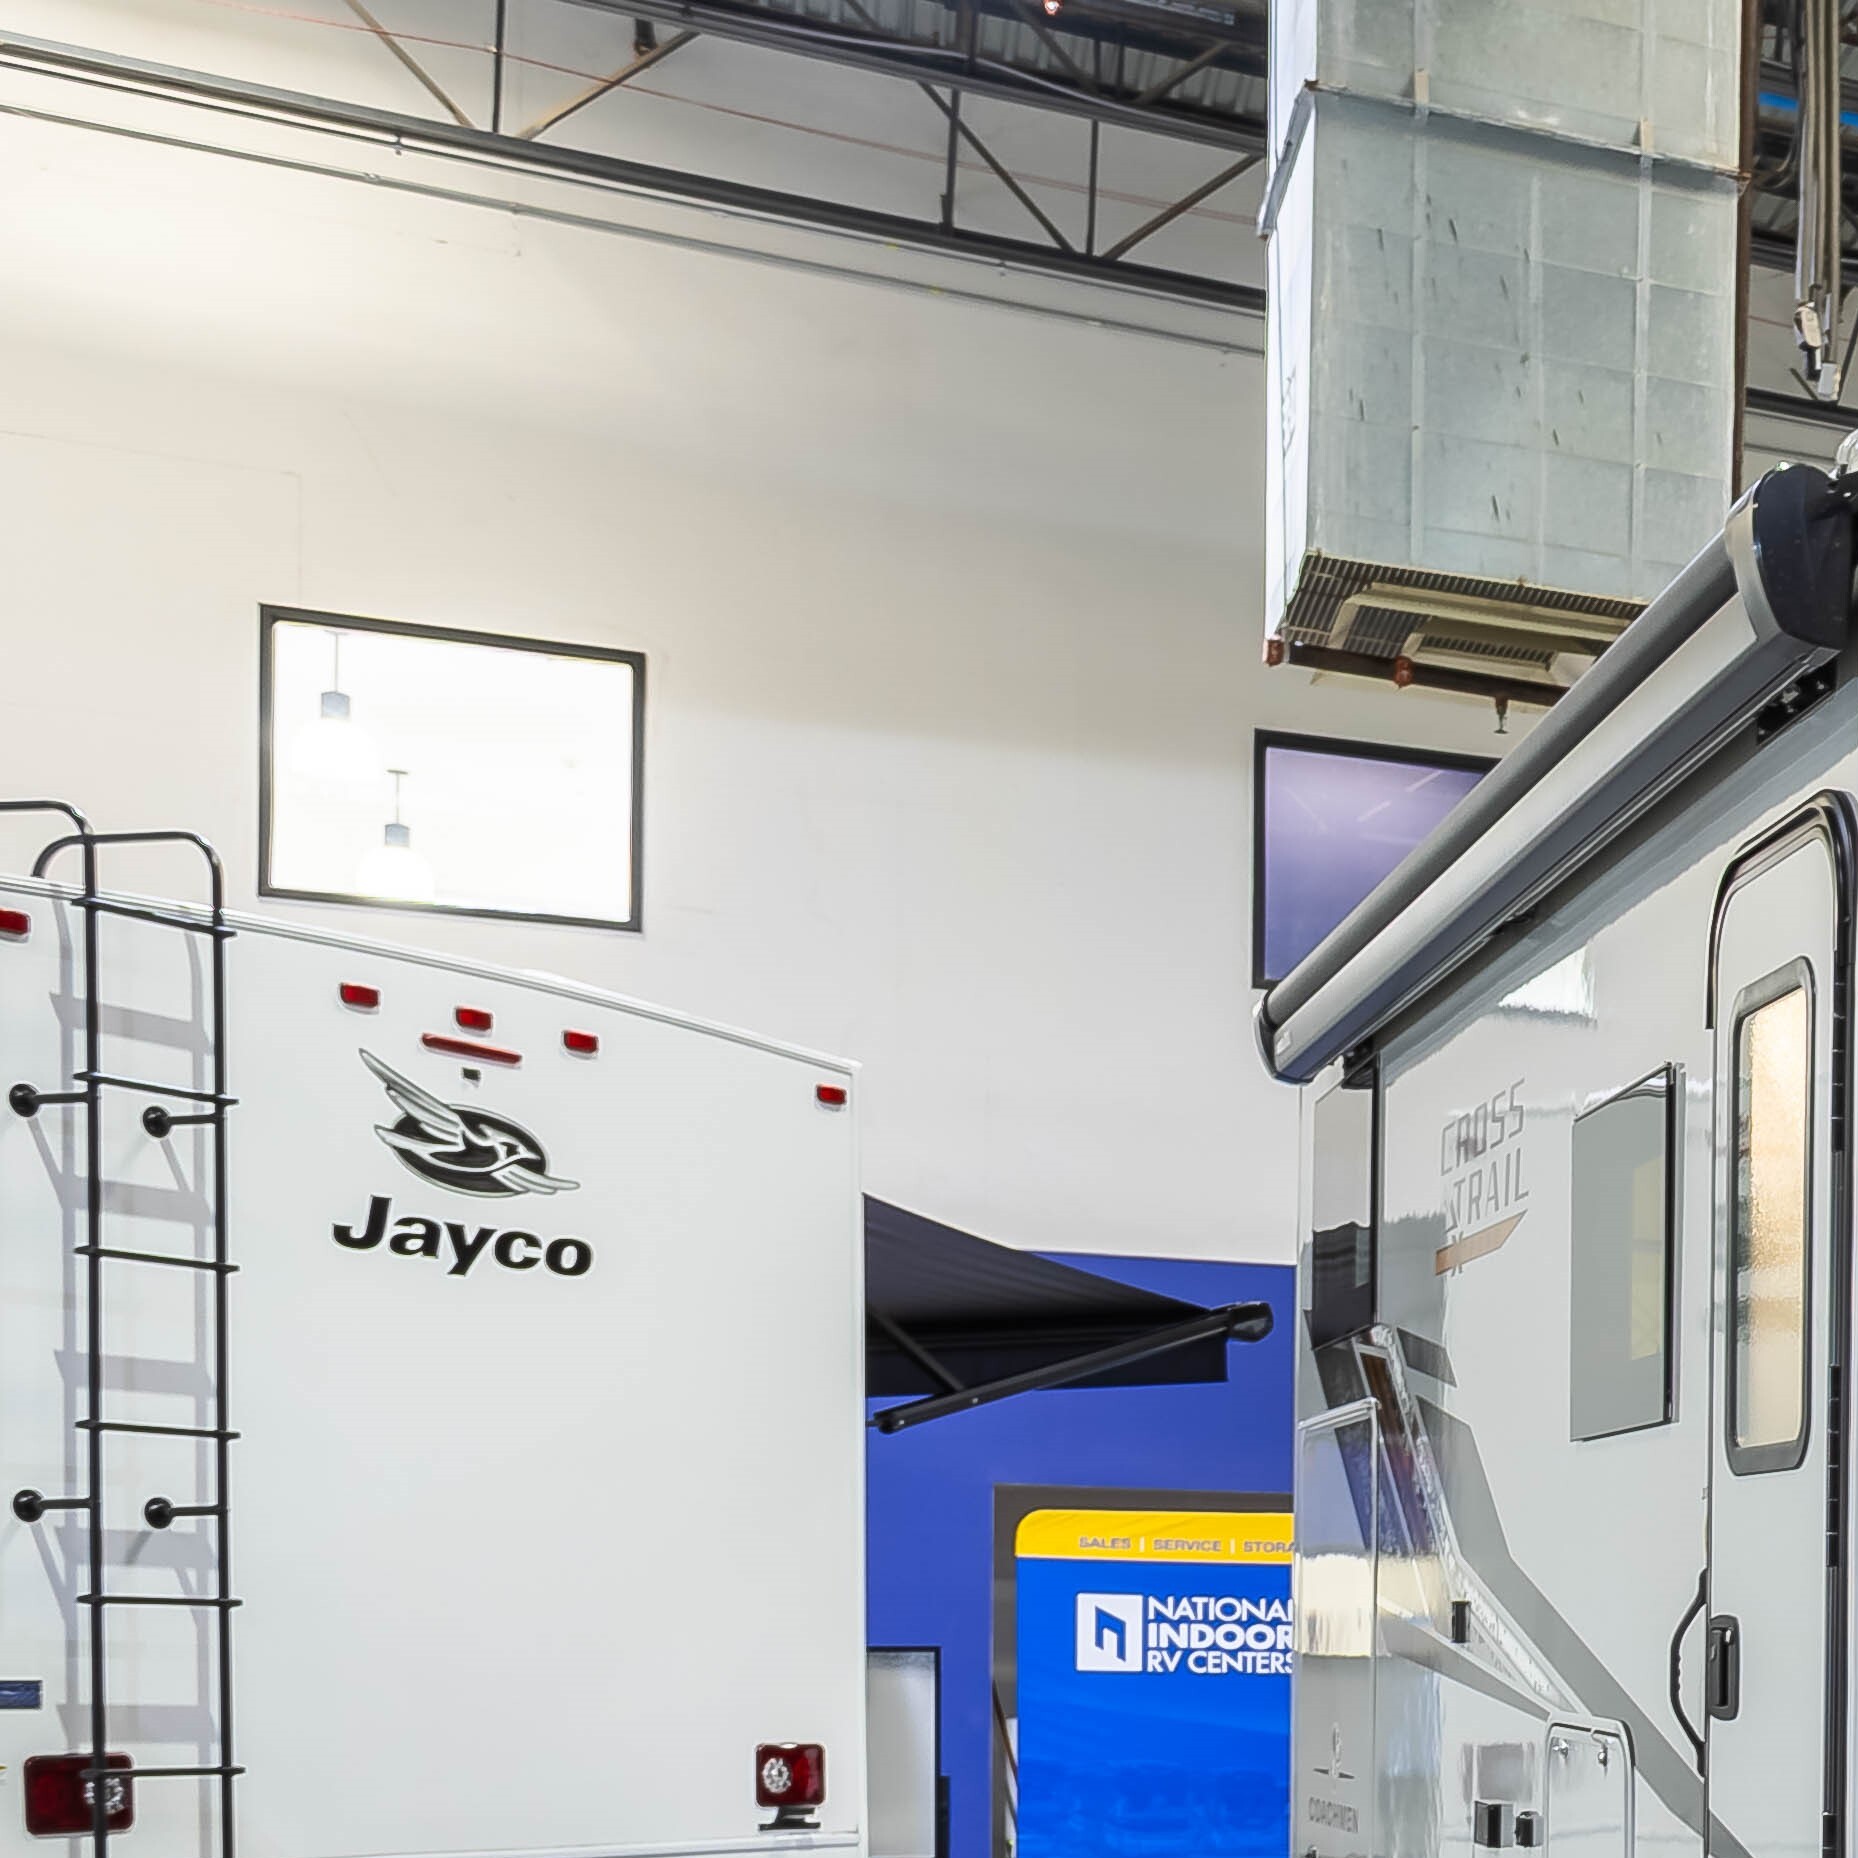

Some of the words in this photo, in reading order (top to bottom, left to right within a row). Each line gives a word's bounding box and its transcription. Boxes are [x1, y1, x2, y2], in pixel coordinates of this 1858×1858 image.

[1440, 1077, 1525, 1176] CROSS
[1453, 1147, 1530, 1224] TRAIL
[332, 1194, 593, 1277] Jayco
[1079, 1536, 1131, 1550] SALES
[1153, 1538, 1222, 1552] SERVICE
[1148, 1623, 1293, 1651] INDOOR
[1148, 1650, 1183, 1673] RV
